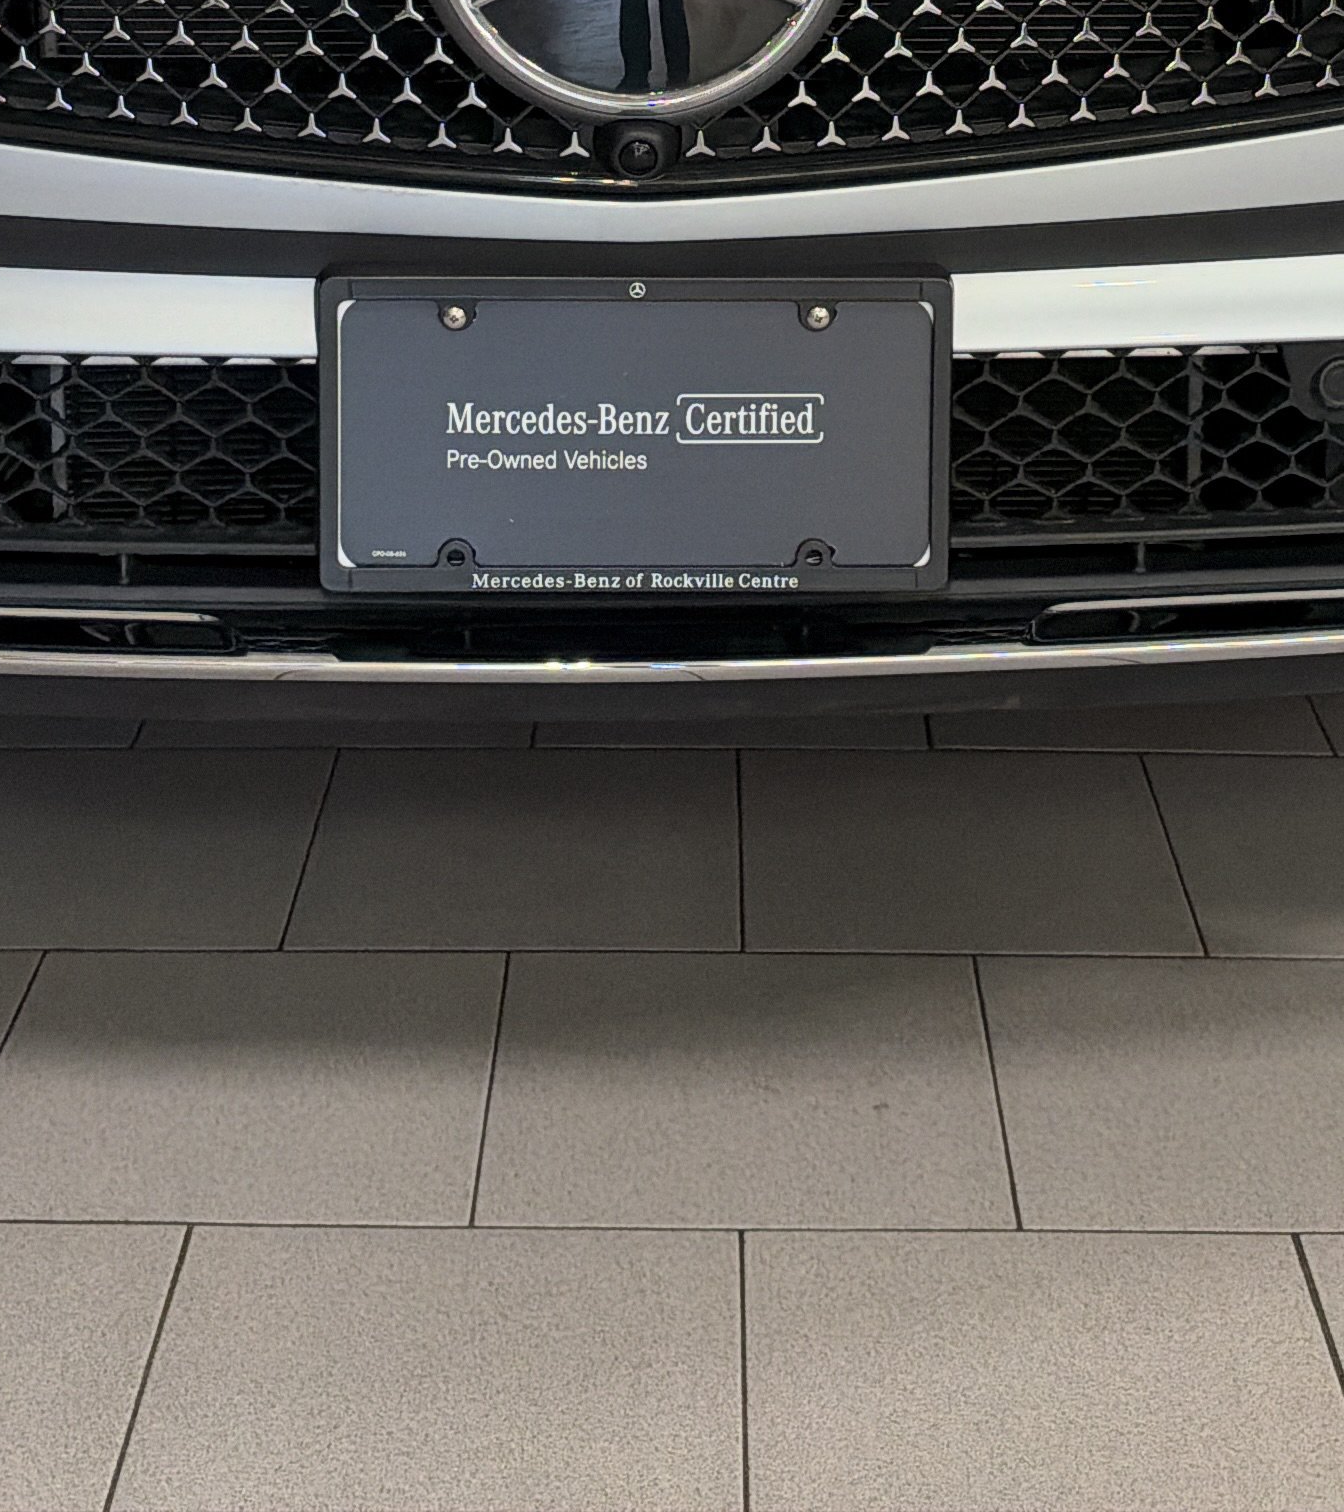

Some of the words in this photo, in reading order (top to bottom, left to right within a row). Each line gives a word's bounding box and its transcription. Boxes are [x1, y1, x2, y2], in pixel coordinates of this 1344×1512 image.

[445, 402, 670, 435] Mercedes-Benz
[685, 402, 815, 435] Certified
[447, 450, 557, 470] Pre-Owned
[564, 450, 648, 470] Vehicles
[472, 573, 621, 588] Mercedes-Benz
[625, 573, 645, 588] of
[650, 573, 734, 588] Rockville
[738, 573, 799, 588] Centre
